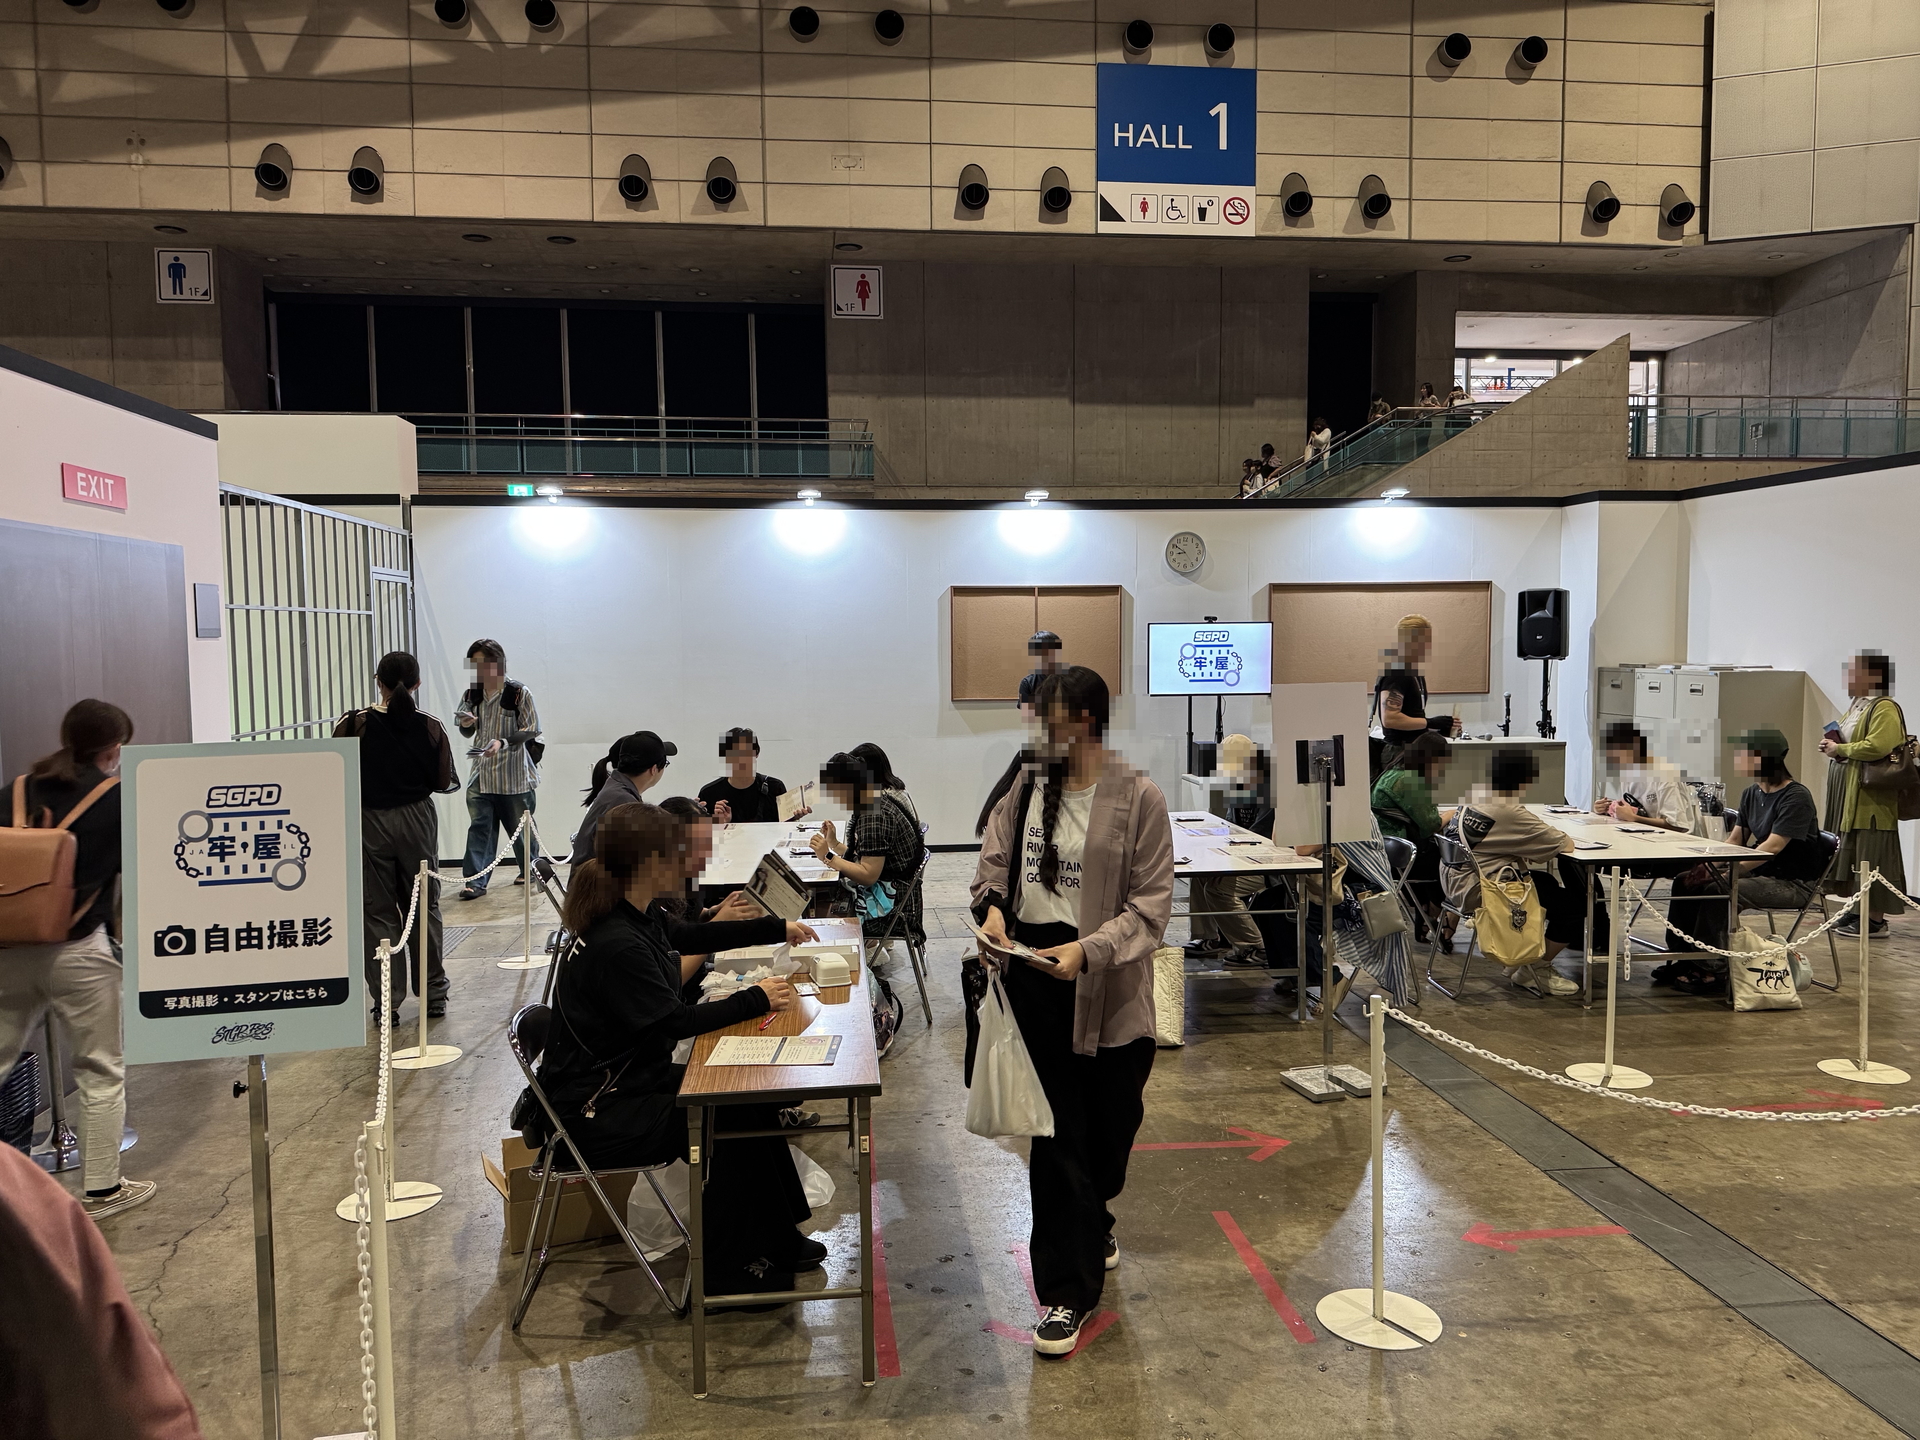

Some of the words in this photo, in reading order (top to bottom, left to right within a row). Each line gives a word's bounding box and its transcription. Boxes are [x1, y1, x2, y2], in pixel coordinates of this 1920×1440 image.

[1113, 122, 1193, 149] HALL
[1208, 102, 1228, 150] 1
[188, 287, 200, 297] 1F
[844, 302, 856, 312] 1F
[76, 471, 114, 502] EXIT
[1193, 630, 1230, 643] SGPD
[206, 783, 282, 809] SGPD
[1026, 841, 1059, 856] RIVR
[1026, 856, 1083, 874] MOTAIN
[1060, 875, 1080, 889] FOR
[204, 916, 333, 954] 自由撮影
[163, 986, 328, 1010] 写真撮影・スタンプはこちら
